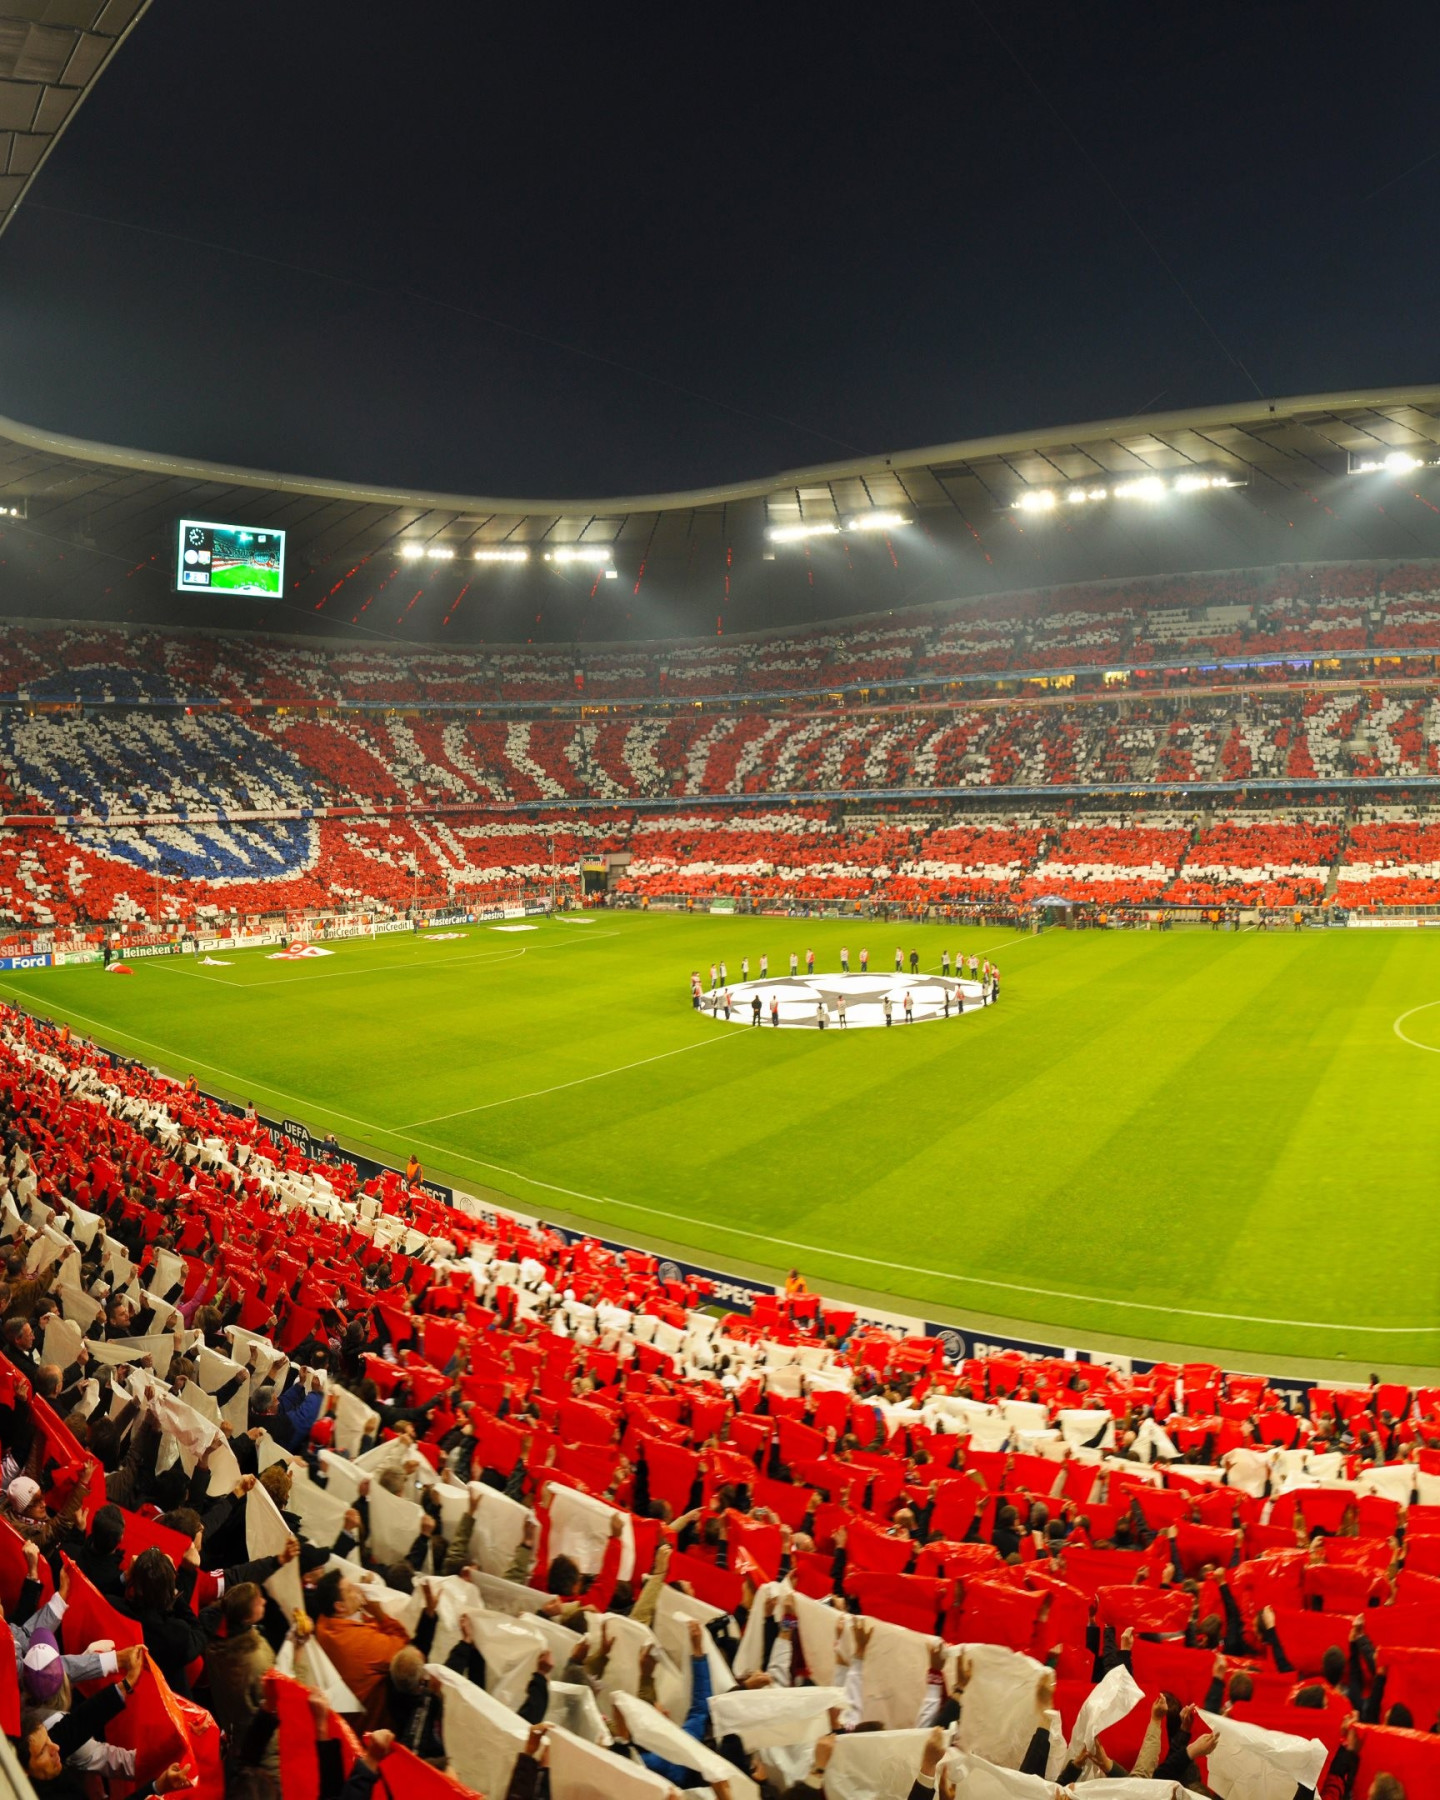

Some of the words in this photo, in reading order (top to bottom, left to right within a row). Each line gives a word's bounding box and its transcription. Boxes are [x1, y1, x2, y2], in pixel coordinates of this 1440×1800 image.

[430, 914, 467, 927] MasterCard
[323, 924, 360, 938] UniCredit
[373, 922, 408, 933] UniCredit
[131, 933, 169, 946] SHARKS
[203, 938, 236, 951] PS3
[123, 945, 171, 958] Heineken
[12, 954, 46, 969] Ford
[284, 1121, 309, 1140] UEFA
[401, 1179, 447, 1203] RPECT
